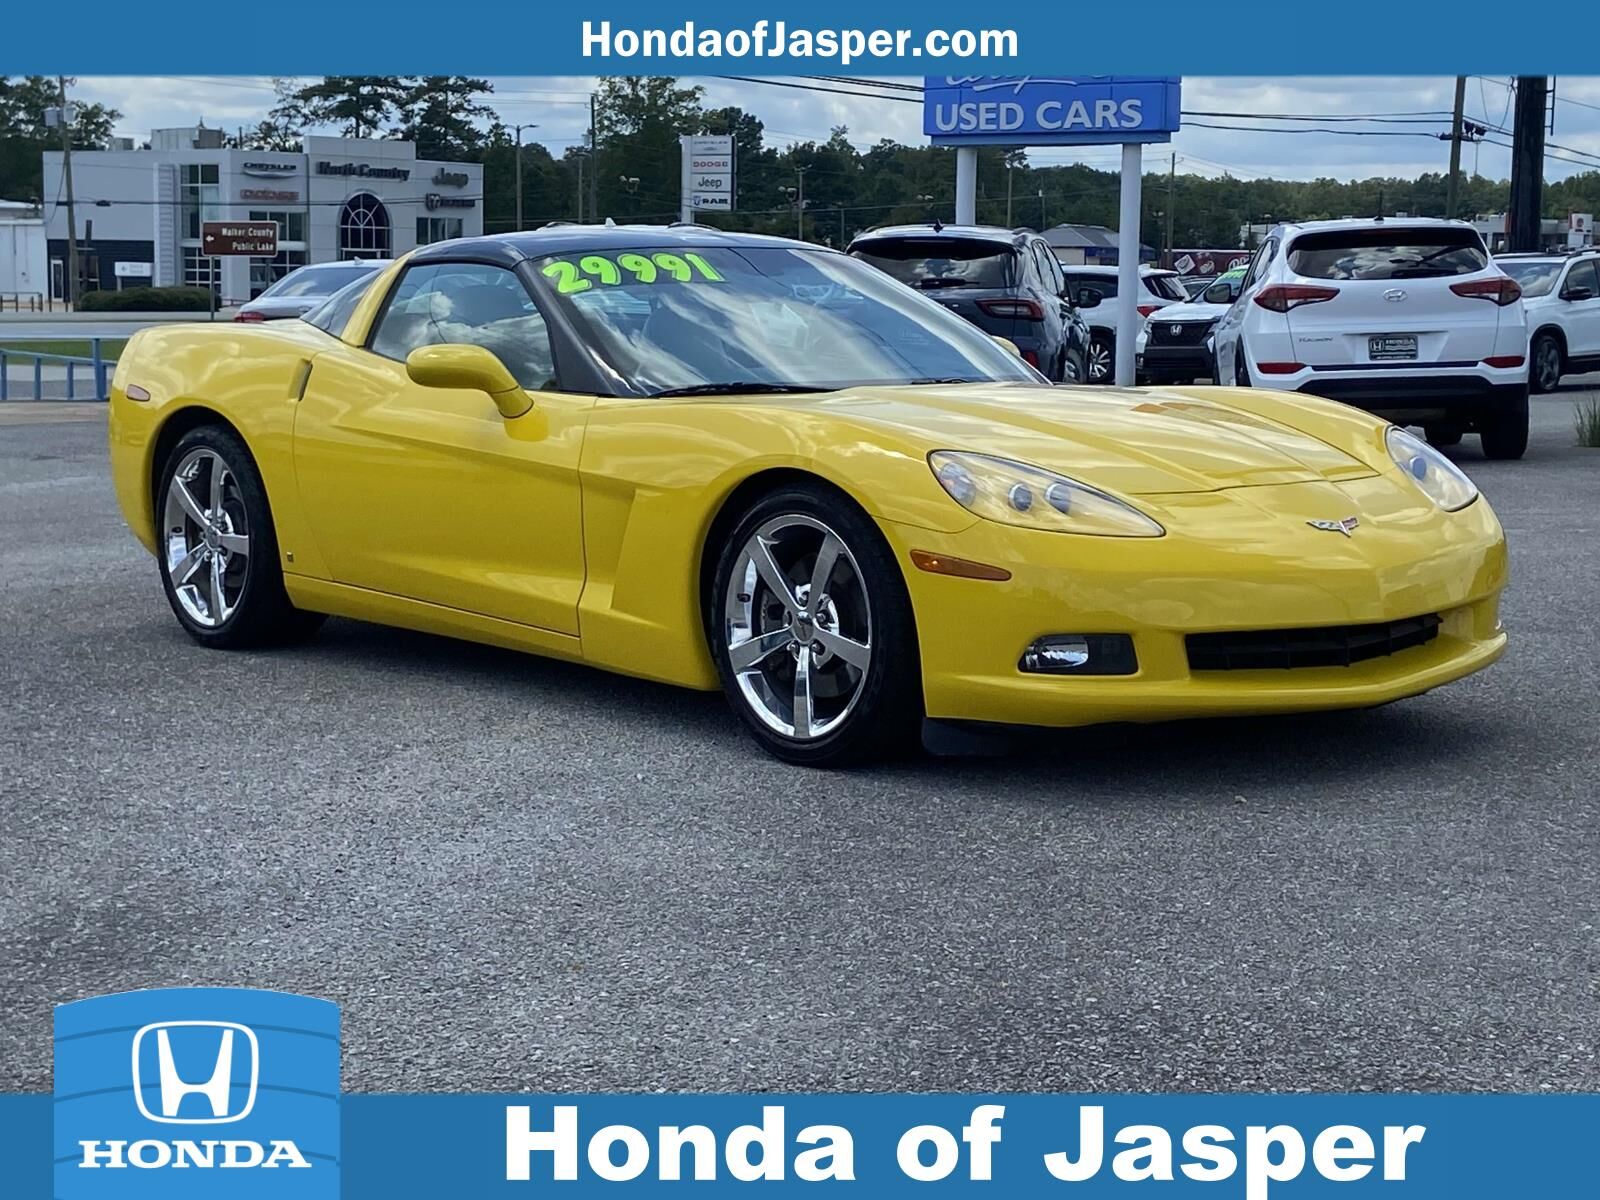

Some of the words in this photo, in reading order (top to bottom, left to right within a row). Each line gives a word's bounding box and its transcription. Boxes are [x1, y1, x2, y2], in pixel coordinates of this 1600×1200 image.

[935, 103, 1025, 131] USED
[1035, 99, 1143, 129] CARS
[698, 176, 722, 189] Jeep
[221, 227, 246, 236] Walker
[248, 227, 274, 238] County
[232, 241, 255, 251] Public
[256, 242, 274, 251] Lake
[541, 252, 725, 294] 29991
